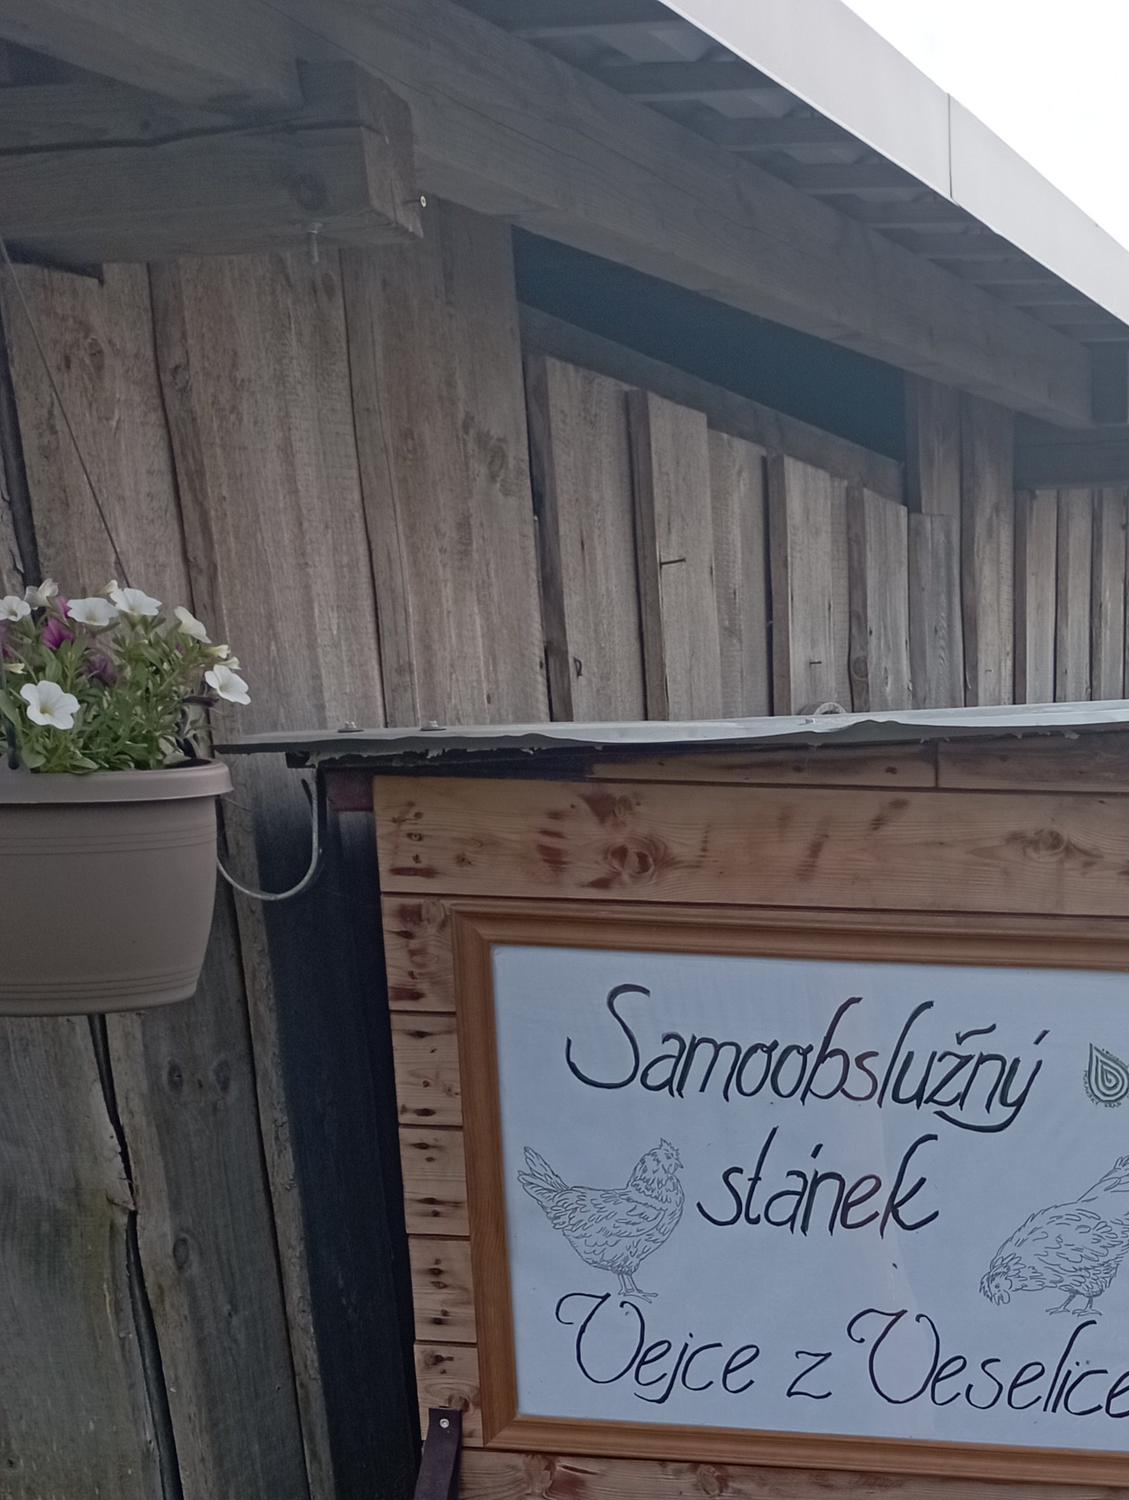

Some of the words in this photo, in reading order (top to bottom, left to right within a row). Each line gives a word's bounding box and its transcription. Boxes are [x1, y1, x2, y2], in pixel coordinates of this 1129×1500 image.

[564, 984, 1050, 1134] Samoobslužný
[696, 1126, 939, 1239] stánek
[555, 1292, 760, 1404] Vejce
[786, 1351, 833, 1399] z
